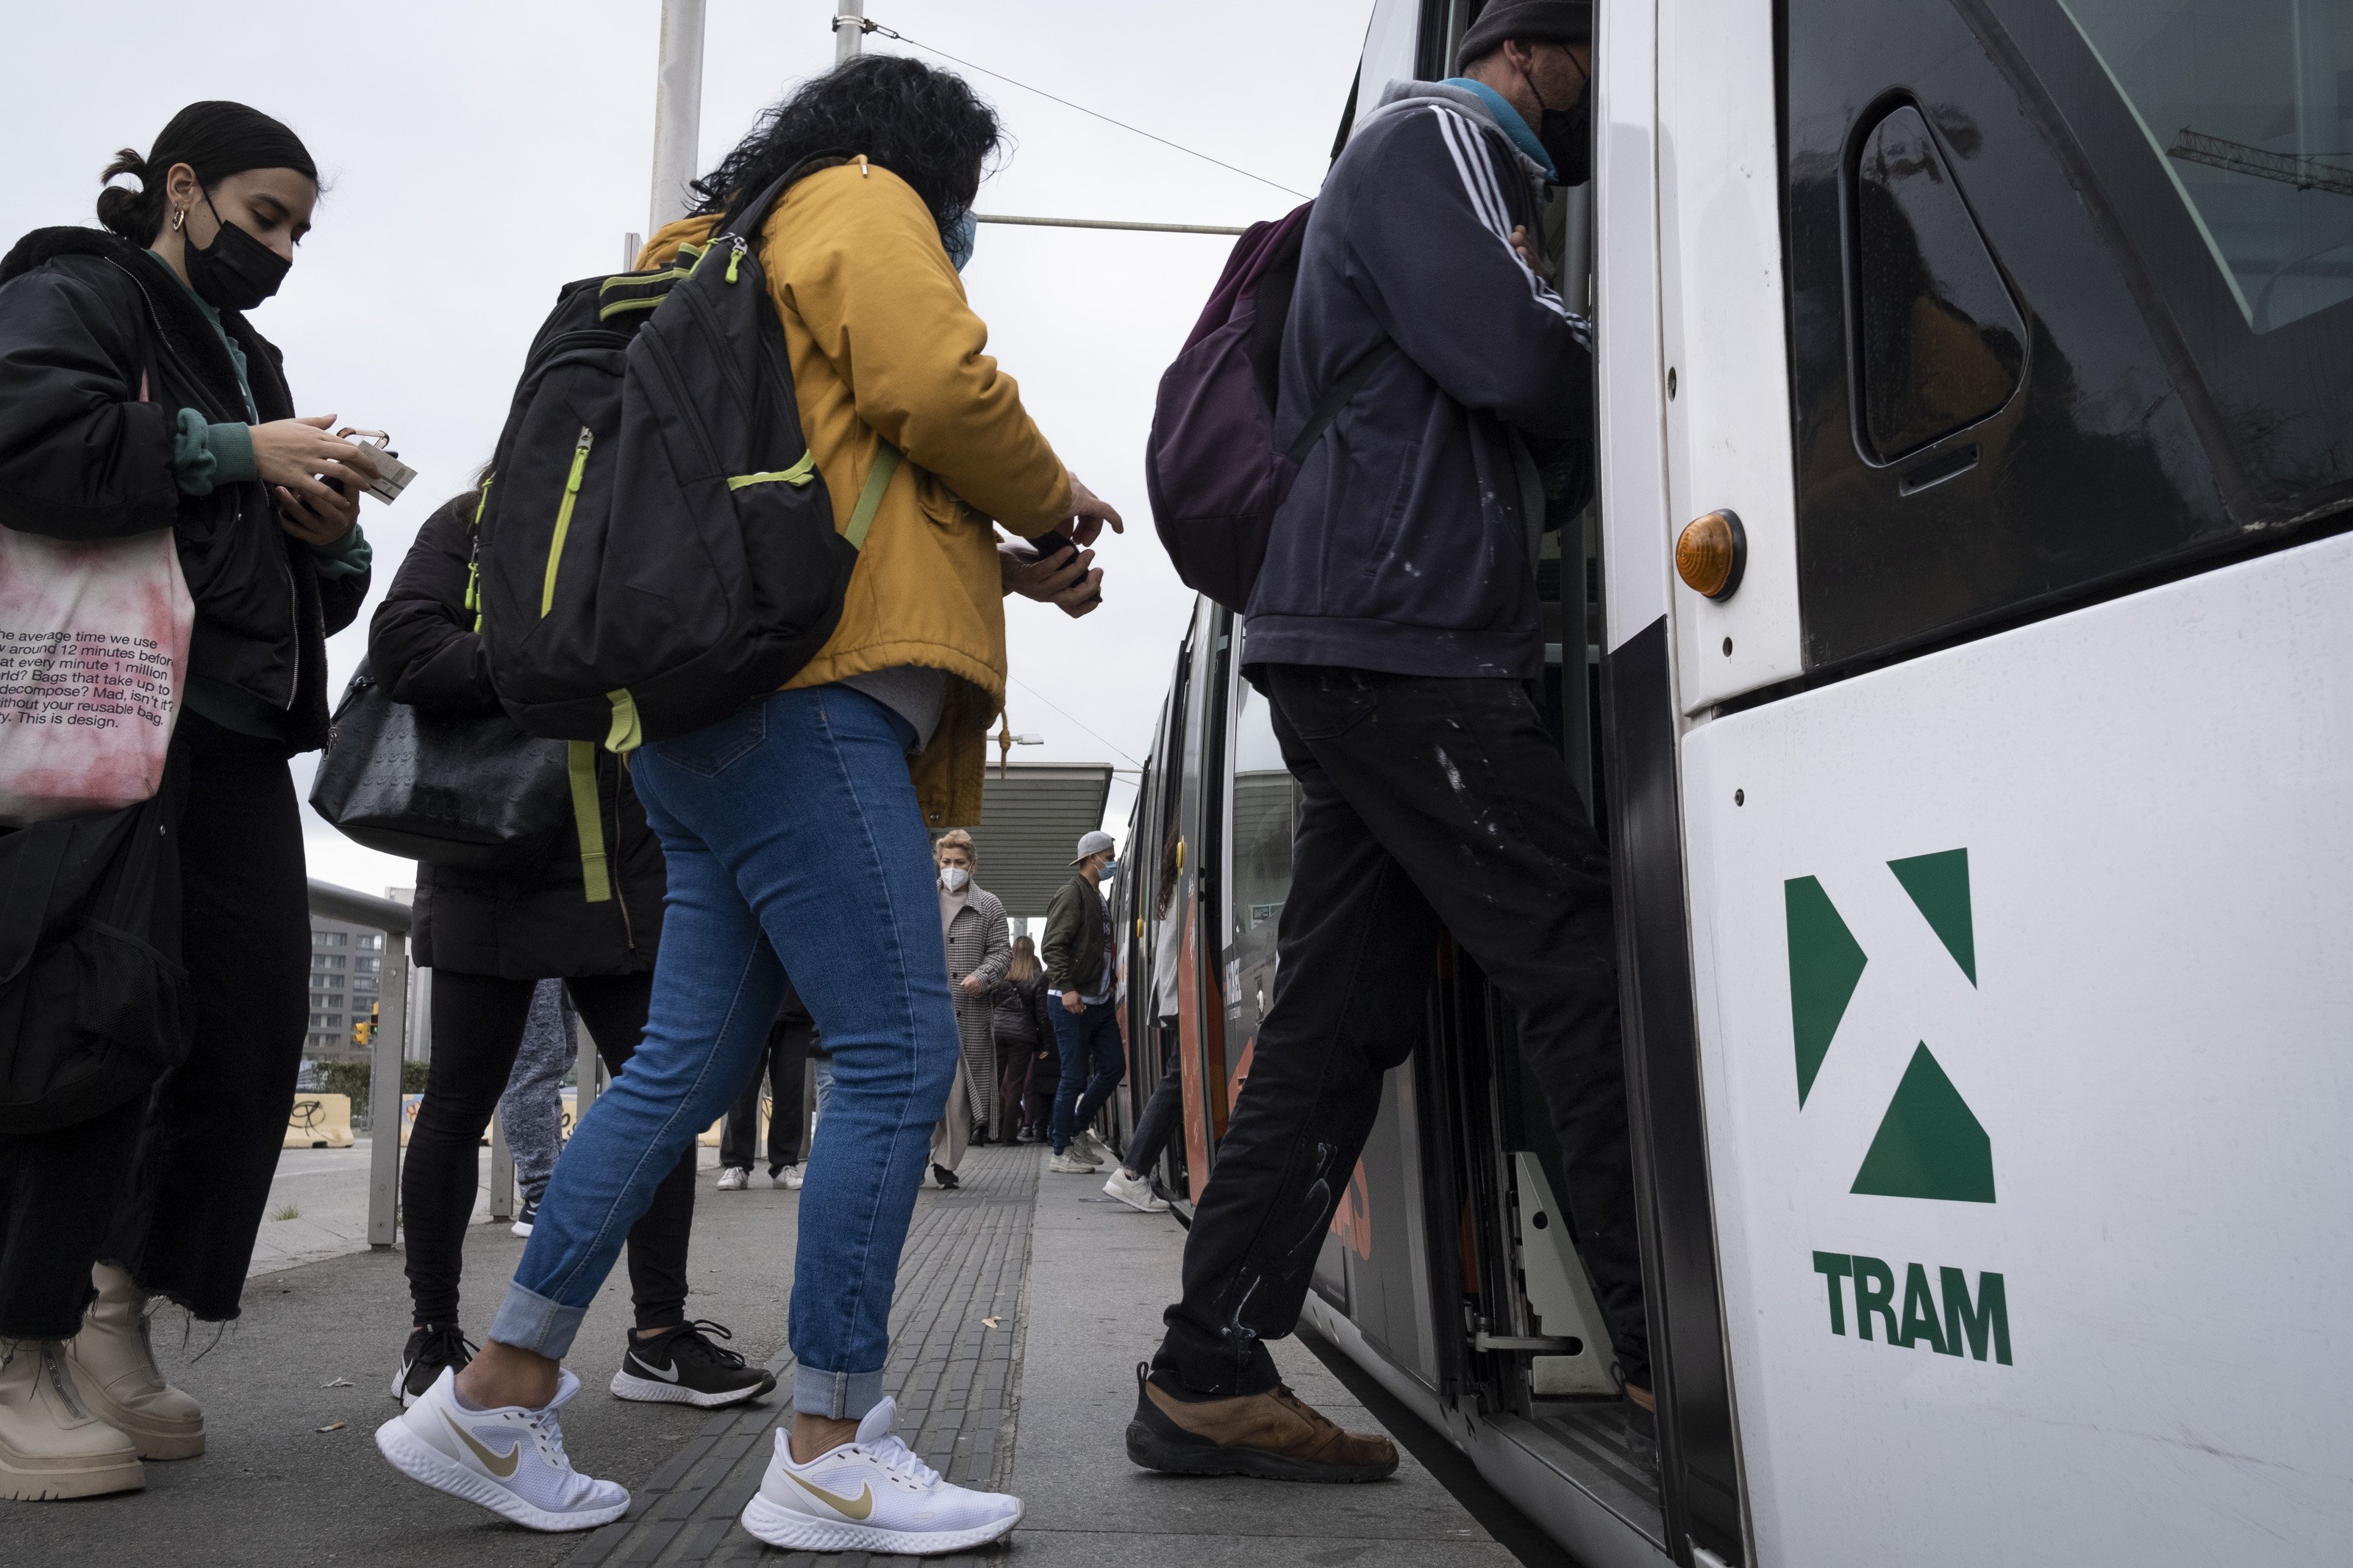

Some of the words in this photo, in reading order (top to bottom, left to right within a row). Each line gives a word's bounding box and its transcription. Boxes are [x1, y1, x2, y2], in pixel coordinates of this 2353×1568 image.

[10, 643, 57, 654] around
[61, 644, 77, 656] 12
[81, 645, 135, 659] minutes
[18, 631, 72, 643] average
[75, 631, 106, 642] time
[110, 635, 130, 645] we
[134, 637, 157, 649] use
[0, 657, 15, 667] at
[18, 658, 56, 671] every
[60, 659, 109, 671] minute
[115, 662, 121, 672] 1
[126, 663, 168, 681] million
[0, 670, 28, 681] rld?
[32, 669, 68, 684] Bags
[72, 672, 101, 684] that
[104, 675, 133, 687] take
[137, 680, 155, 692] up
[159, 684, 171, 696] to
[0, 684, 89, 699] decompose?
[93, 687, 127, 702] Mad,
[161, 698, 174, 712] it?
[0, 697, 40, 710] ithout
[42, 701, 74, 713] your
[77, 702, 134, 715] reusable
[137, 705, 163, 726] bag.
[0, 712, 12, 724] y.
[18, 711, 46, 724] This
[51, 712, 63, 724] is
[67, 714, 119, 729] design.
[1813, 1250, 2013, 1367] TRAM
